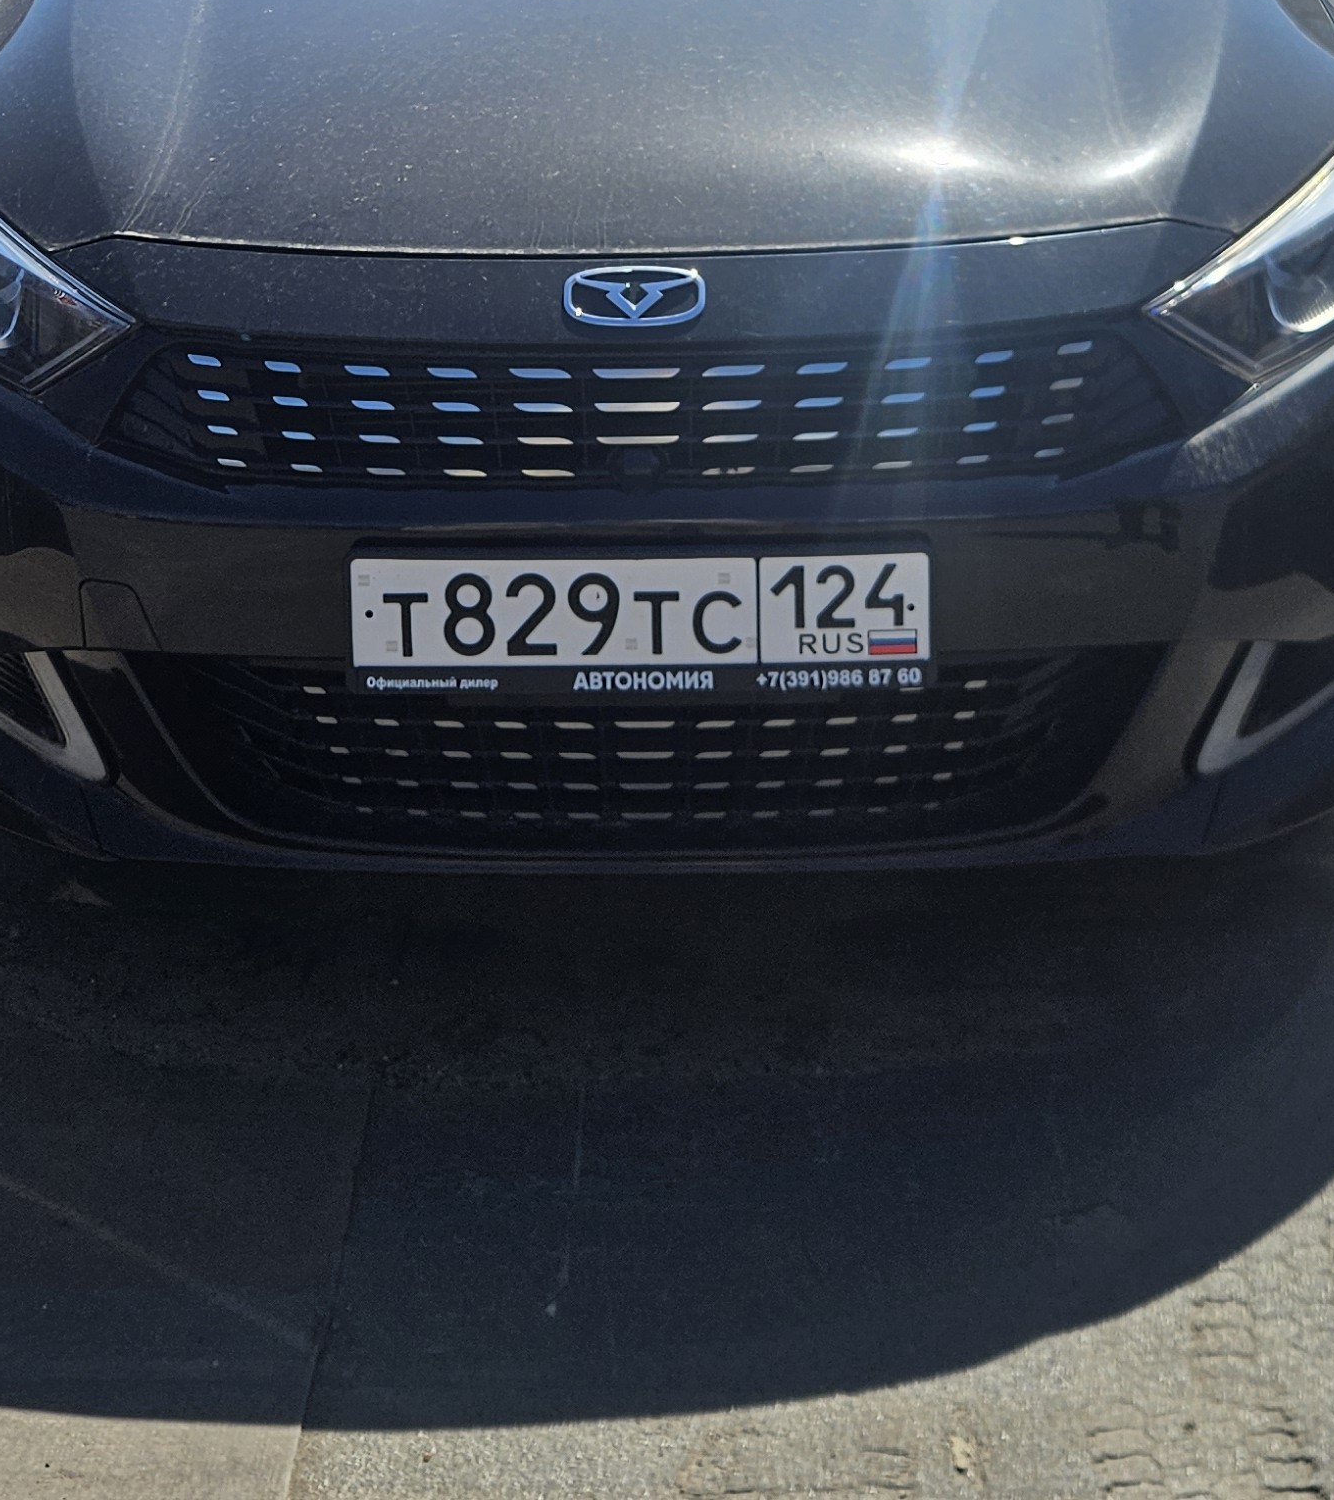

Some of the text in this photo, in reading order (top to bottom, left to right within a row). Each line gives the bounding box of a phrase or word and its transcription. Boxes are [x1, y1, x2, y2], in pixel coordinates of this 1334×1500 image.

[382, 563, 906, 658] Т829ТС 124
[798, 632, 865, 655] RUS
[366, 667, 923, 691] Официальный дилер АВТОНОМИЯ +7(391)986 87 60
